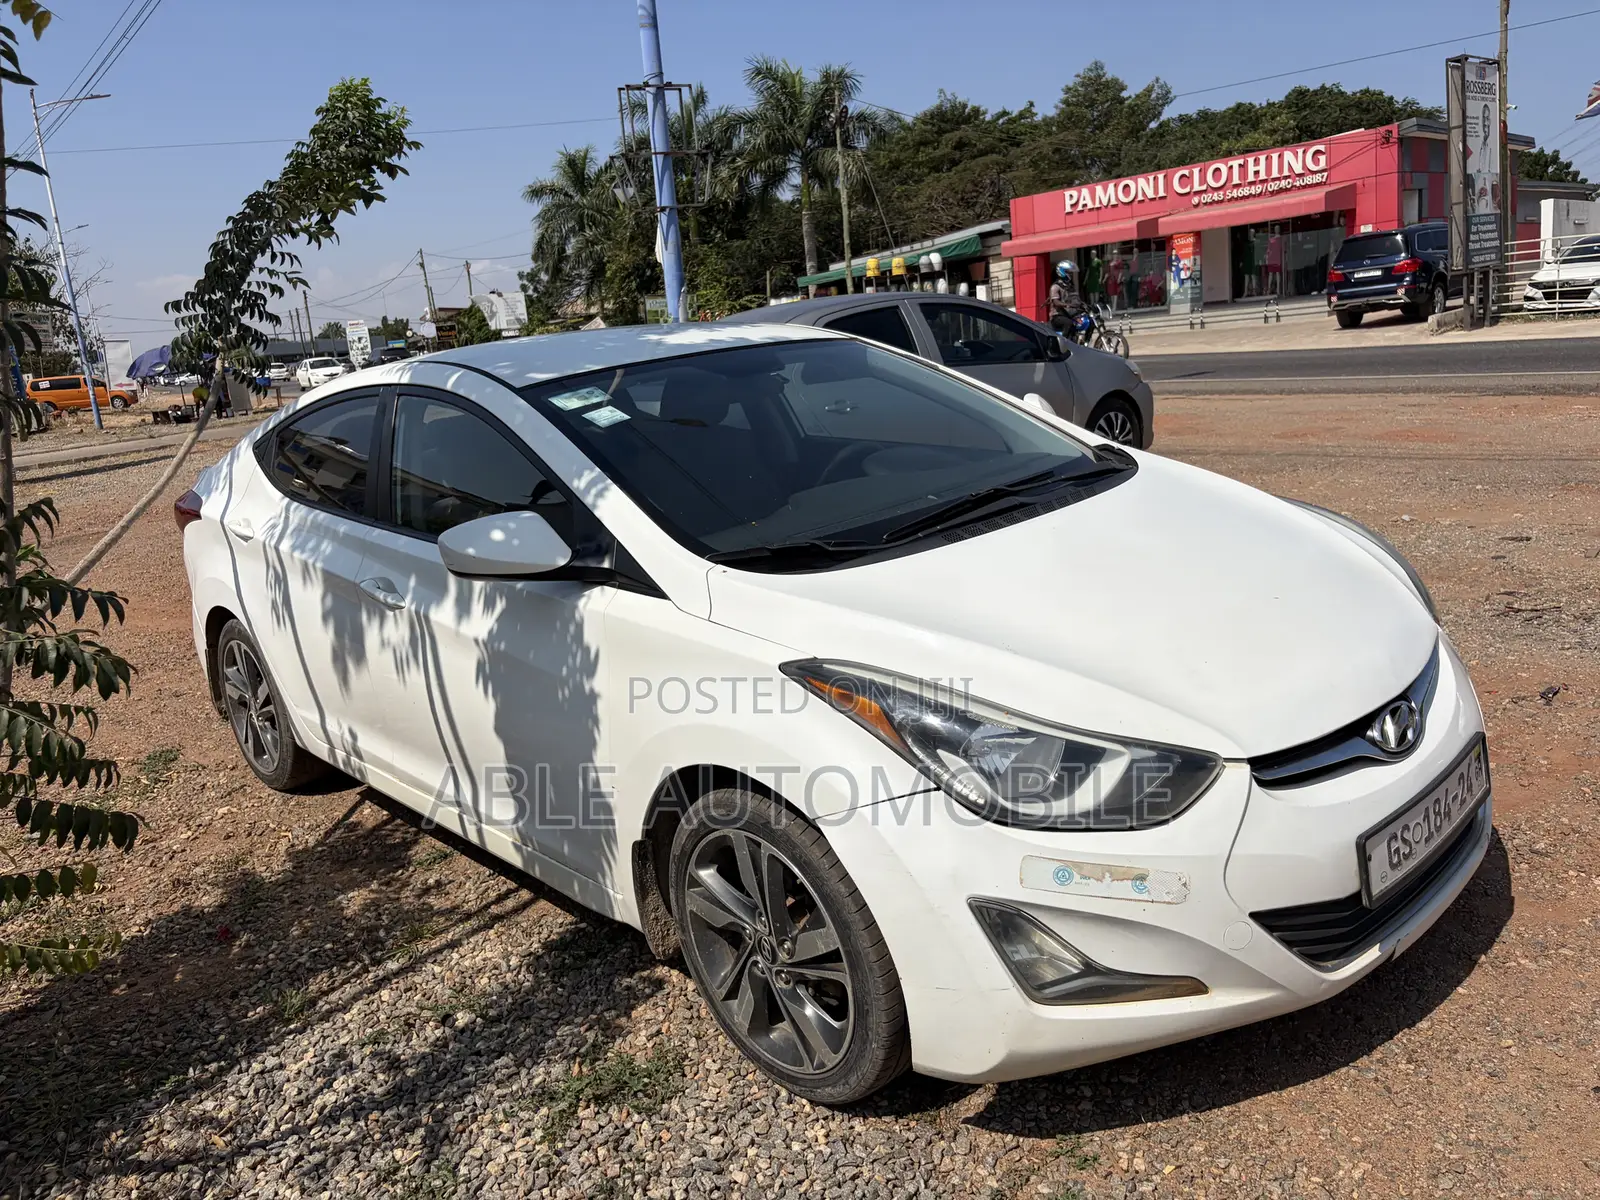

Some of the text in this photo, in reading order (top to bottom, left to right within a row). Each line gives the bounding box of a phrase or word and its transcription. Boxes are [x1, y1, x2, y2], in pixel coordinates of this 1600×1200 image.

[1466, 80, 1496, 96] ROSSBERG
[1063, 144, 1328, 214] PAMONI CLOTHING
[1386, 763, 1474, 872] GS 184-24
